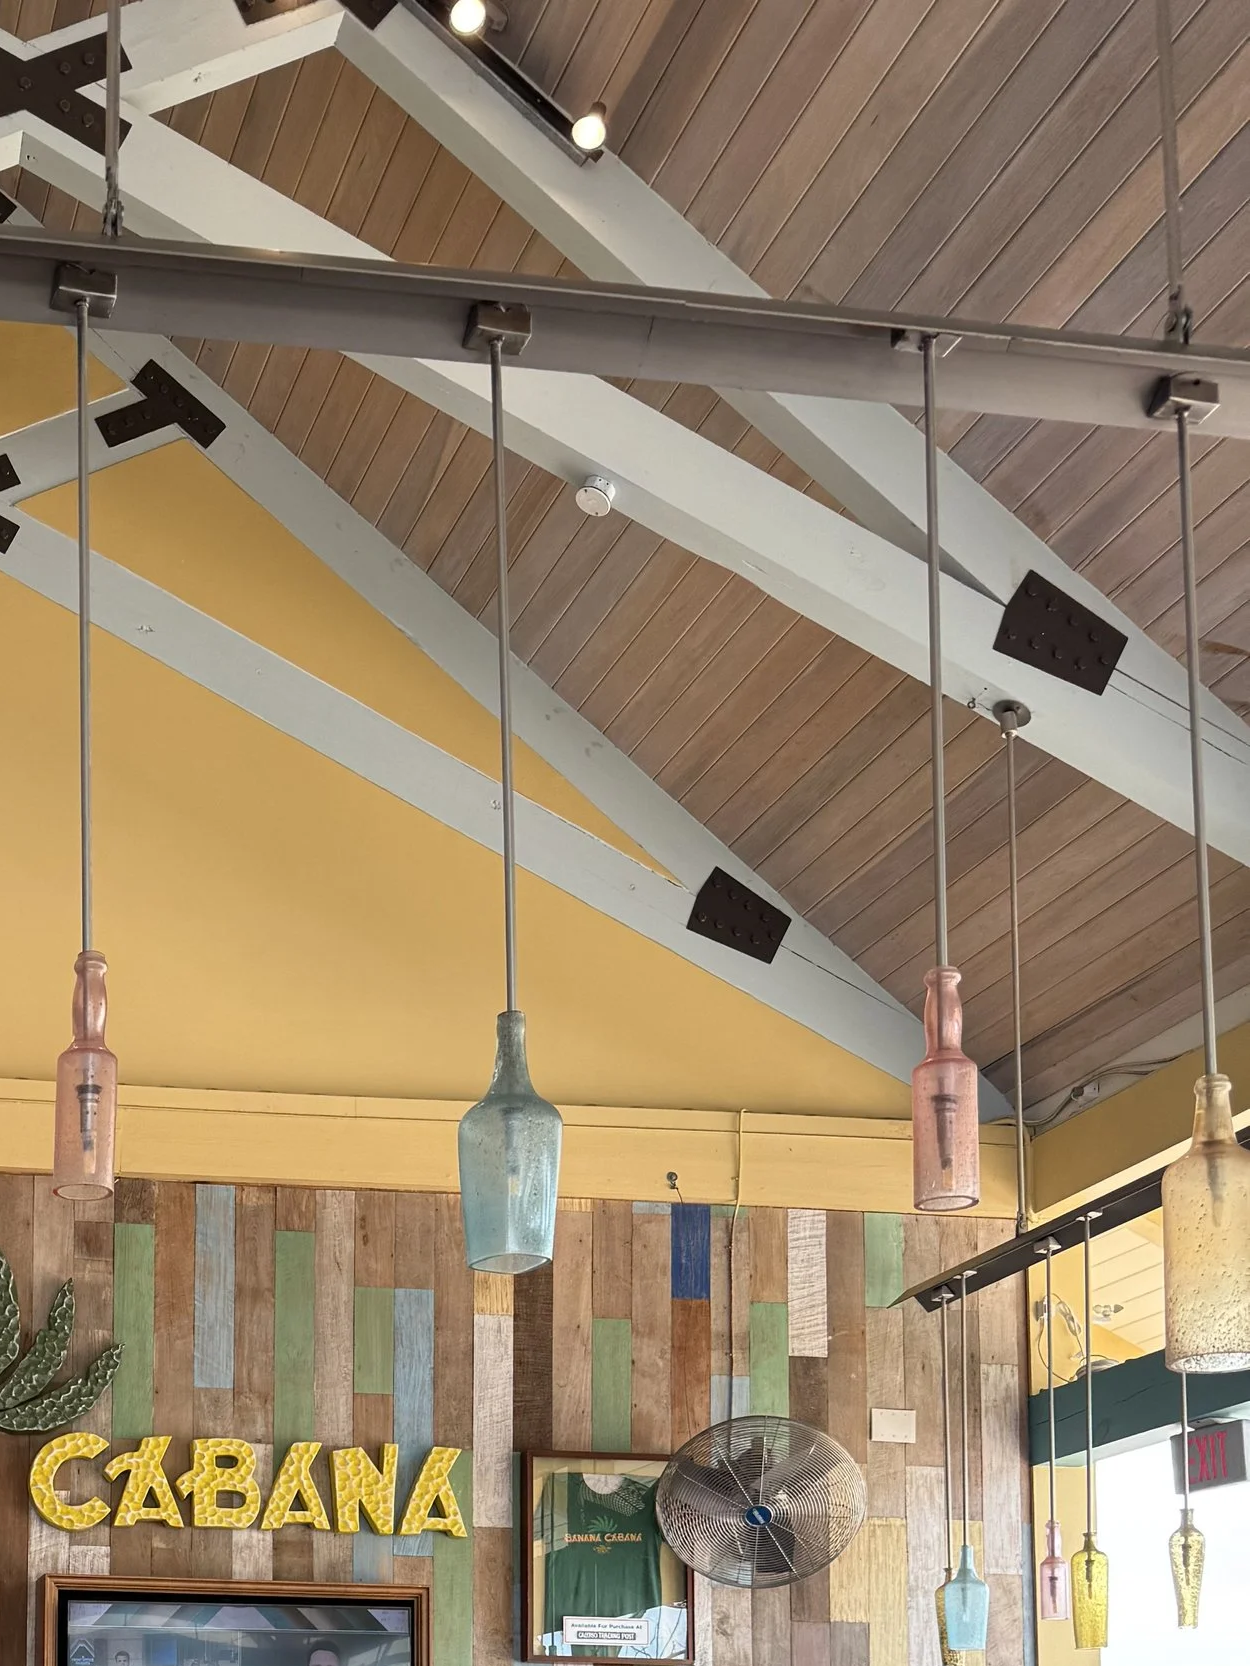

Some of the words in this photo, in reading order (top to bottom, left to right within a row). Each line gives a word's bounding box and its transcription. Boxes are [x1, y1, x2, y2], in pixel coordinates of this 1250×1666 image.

[27, 1431, 469, 1538] CABANA
[564, 1533, 601, 1543] BANANA
[604, 1532, 642, 1542] CABANA
